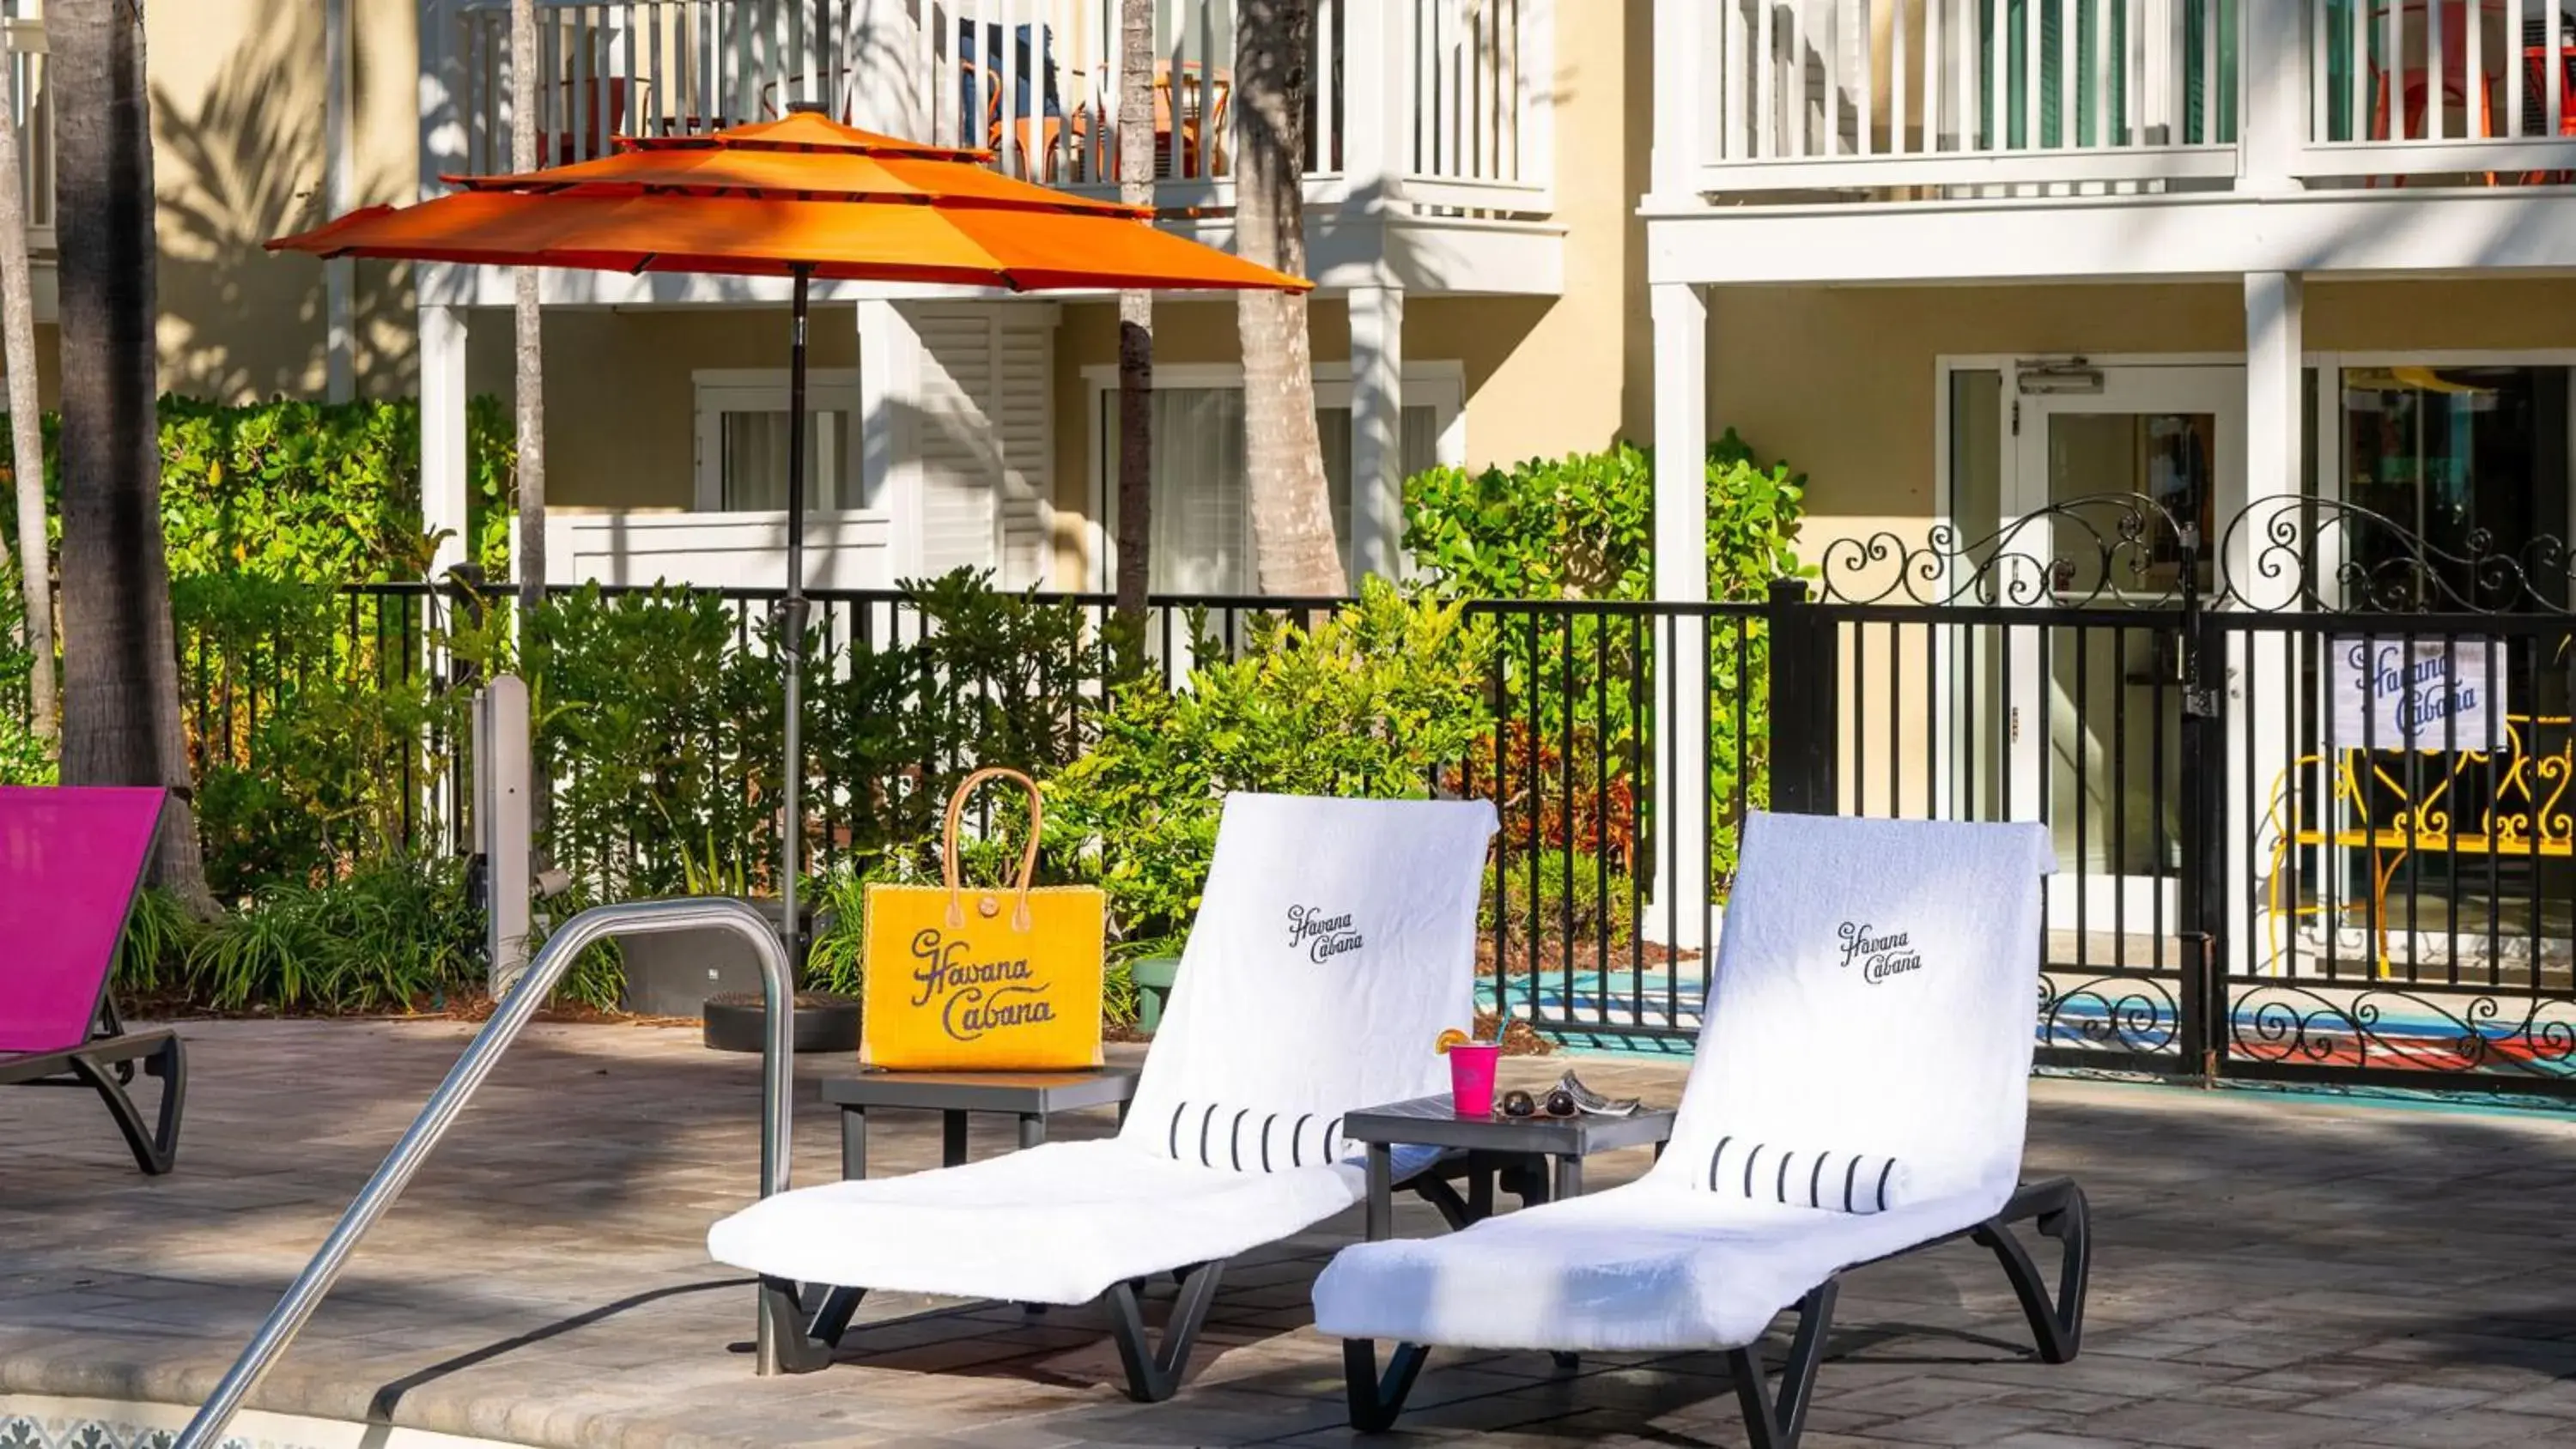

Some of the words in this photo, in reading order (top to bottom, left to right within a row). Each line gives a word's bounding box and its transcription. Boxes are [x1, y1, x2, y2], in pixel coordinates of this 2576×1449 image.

[1288, 904, 1352, 948] Havana
[1310, 927, 1364, 964] Cabana
[1838, 921, 1909, 967] Havana
[911, 929, 1032, 1007] Havana
[1864, 949, 1922, 985] Cabana
[942, 983, 1056, 1041] Cabana
